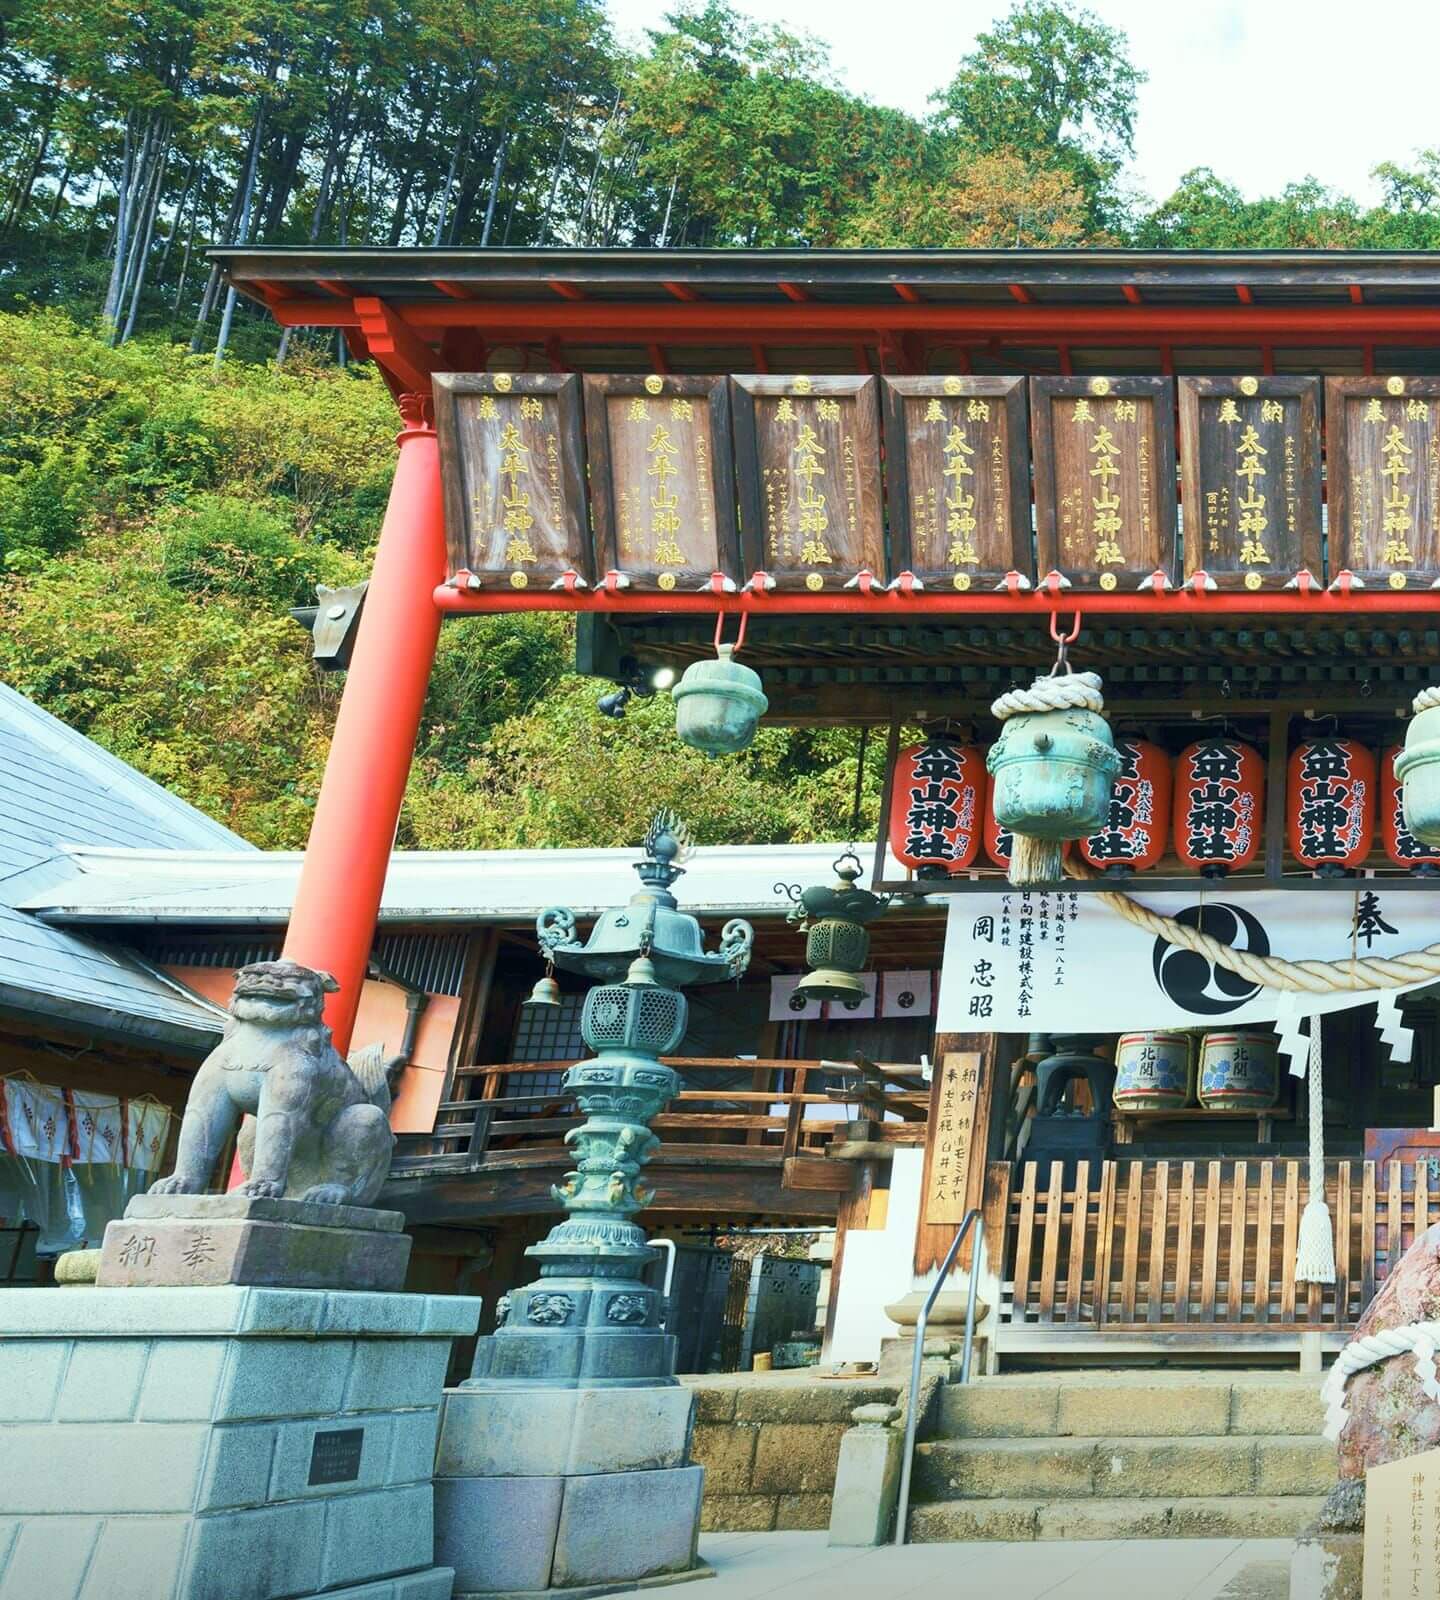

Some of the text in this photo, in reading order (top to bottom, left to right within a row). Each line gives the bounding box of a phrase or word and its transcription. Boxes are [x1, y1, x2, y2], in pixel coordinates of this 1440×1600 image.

[477, 397, 542, 421] 奉納
[627, 398, 692, 422] 奉納
[775, 399, 840, 423] 奉納
[924, 399, 989, 423] 奉納
[1072, 399, 1136, 423] 奉納
[1219, 400, 1283, 423] 奉納
[1364, 399, 1428, 423] 奉納
[498, 423, 536, 562] 太平山神社
[647, 425, 685, 564] 太平山神社
[795, 425, 832, 564] 太平山神社
[944, 426, 979, 565] 太平山神社
[1089, 426, 1126, 565] 太平山神社
[1236, 426, 1270, 565] 太平山神社
[1382, 425, 1414, 563] 太平山神社
[905, 742, 967, 862] 太平山神社
[1187, 742, 1244, 862] 太平山神社
[1299, 741, 1353, 859] 太平山神社
[967, 915, 996, 1019] 岡忠昭
[1001, 895, 1012, 947] 代表取締役
[1017, 891, 1035, 1019] 日向野建設株式会社
